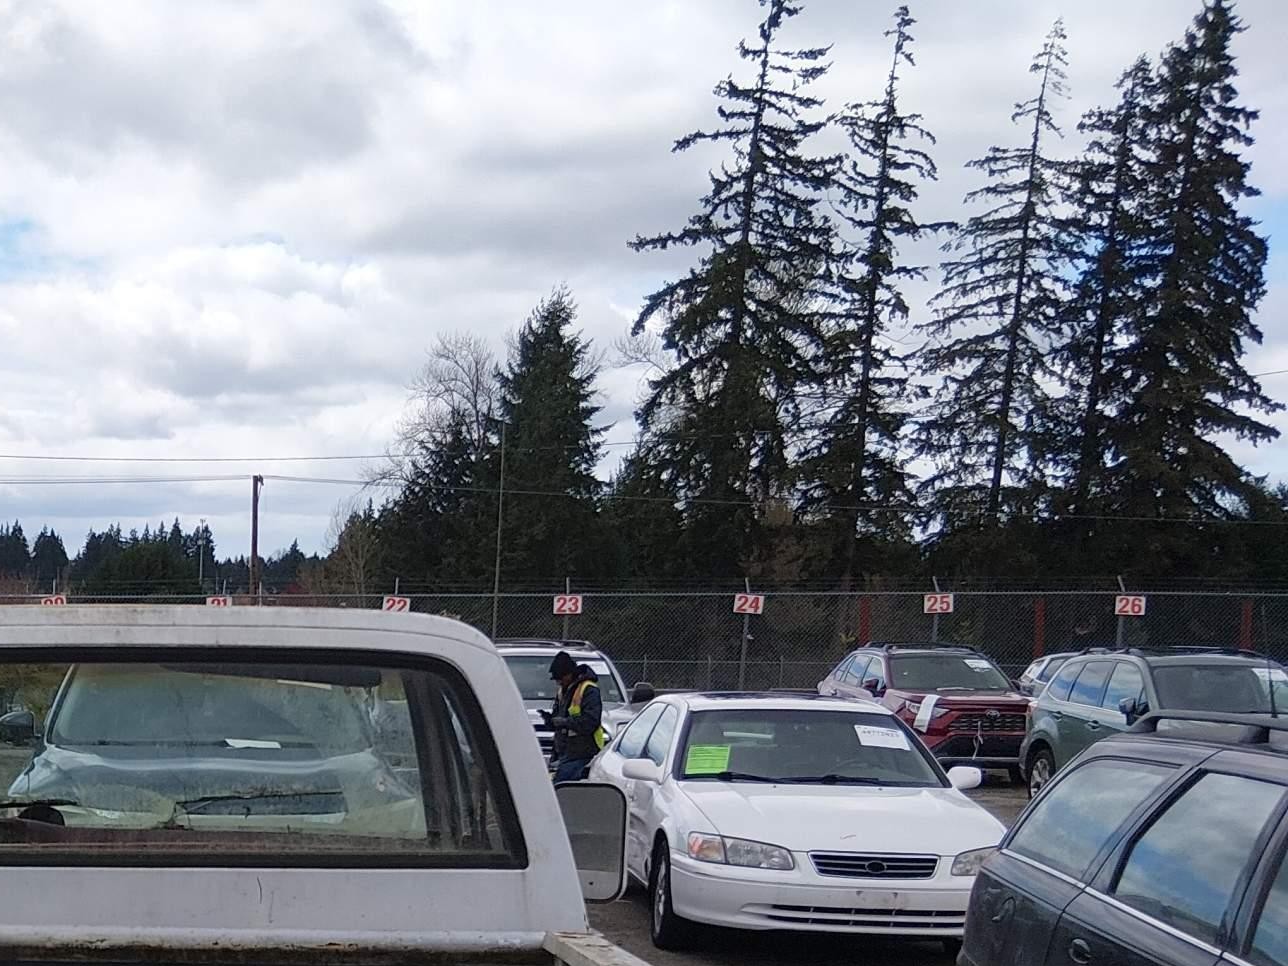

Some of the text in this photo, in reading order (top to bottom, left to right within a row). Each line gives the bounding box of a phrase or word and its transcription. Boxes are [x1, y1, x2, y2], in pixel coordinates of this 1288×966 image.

[385, 598, 407, 612] 22
[557, 596, 579, 613] 23
[736, 595, 760, 613] 24
[927, 595, 951, 612] 25
[1118, 597, 1142, 614] 26
